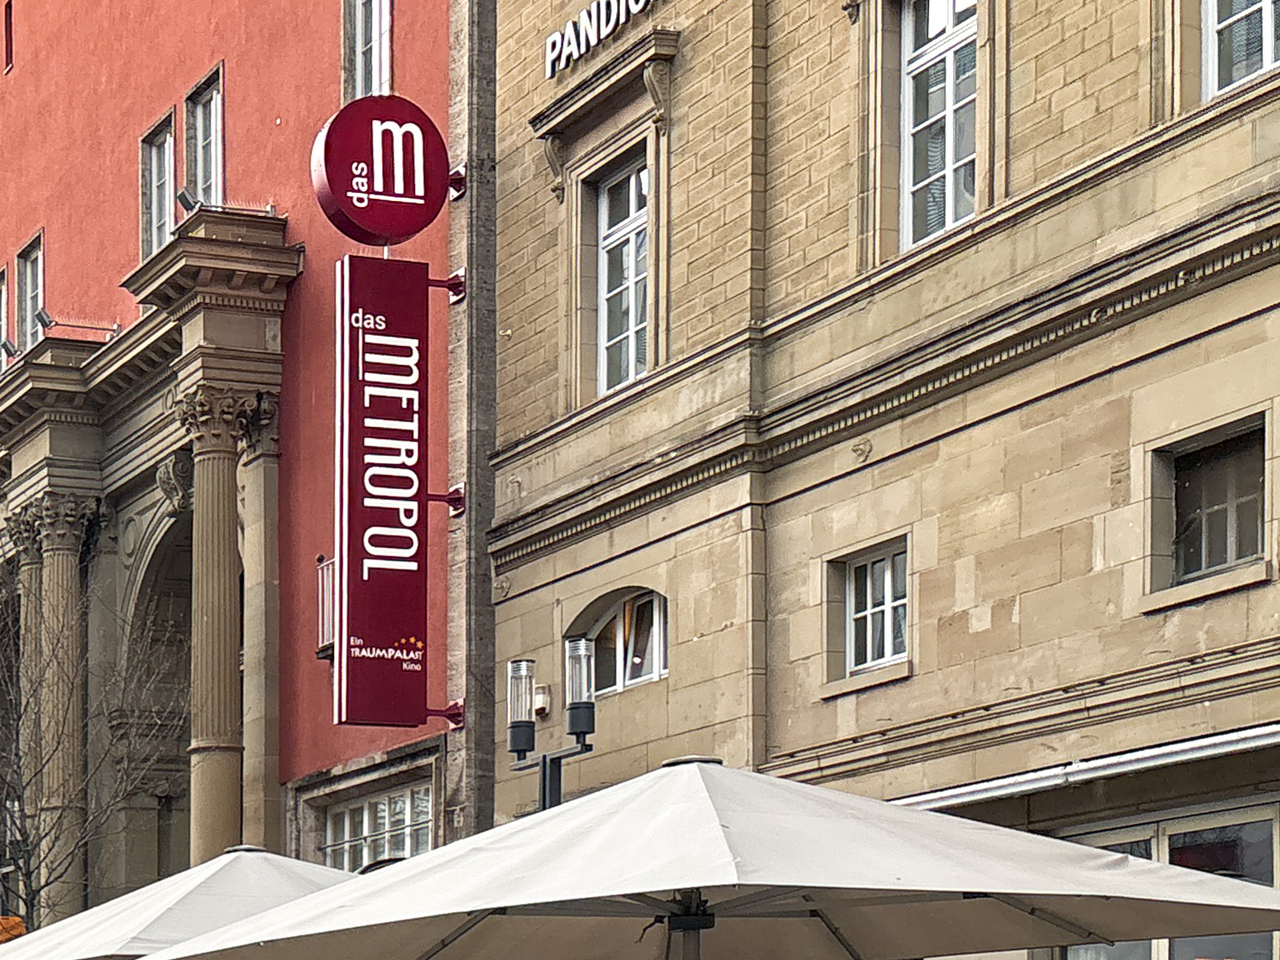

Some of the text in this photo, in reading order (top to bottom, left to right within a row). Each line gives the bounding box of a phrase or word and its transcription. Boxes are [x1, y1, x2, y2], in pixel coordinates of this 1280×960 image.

[545, 0, 651, 79] PANDI
[346, 161, 368, 208] das
[351, 308, 386, 330] das
[362, 333, 419, 581] METROPOL
[350, 636, 364, 647] Ein
[350, 647, 425, 661] TRAUMPALAST
[402, 661, 422, 671] Kino
